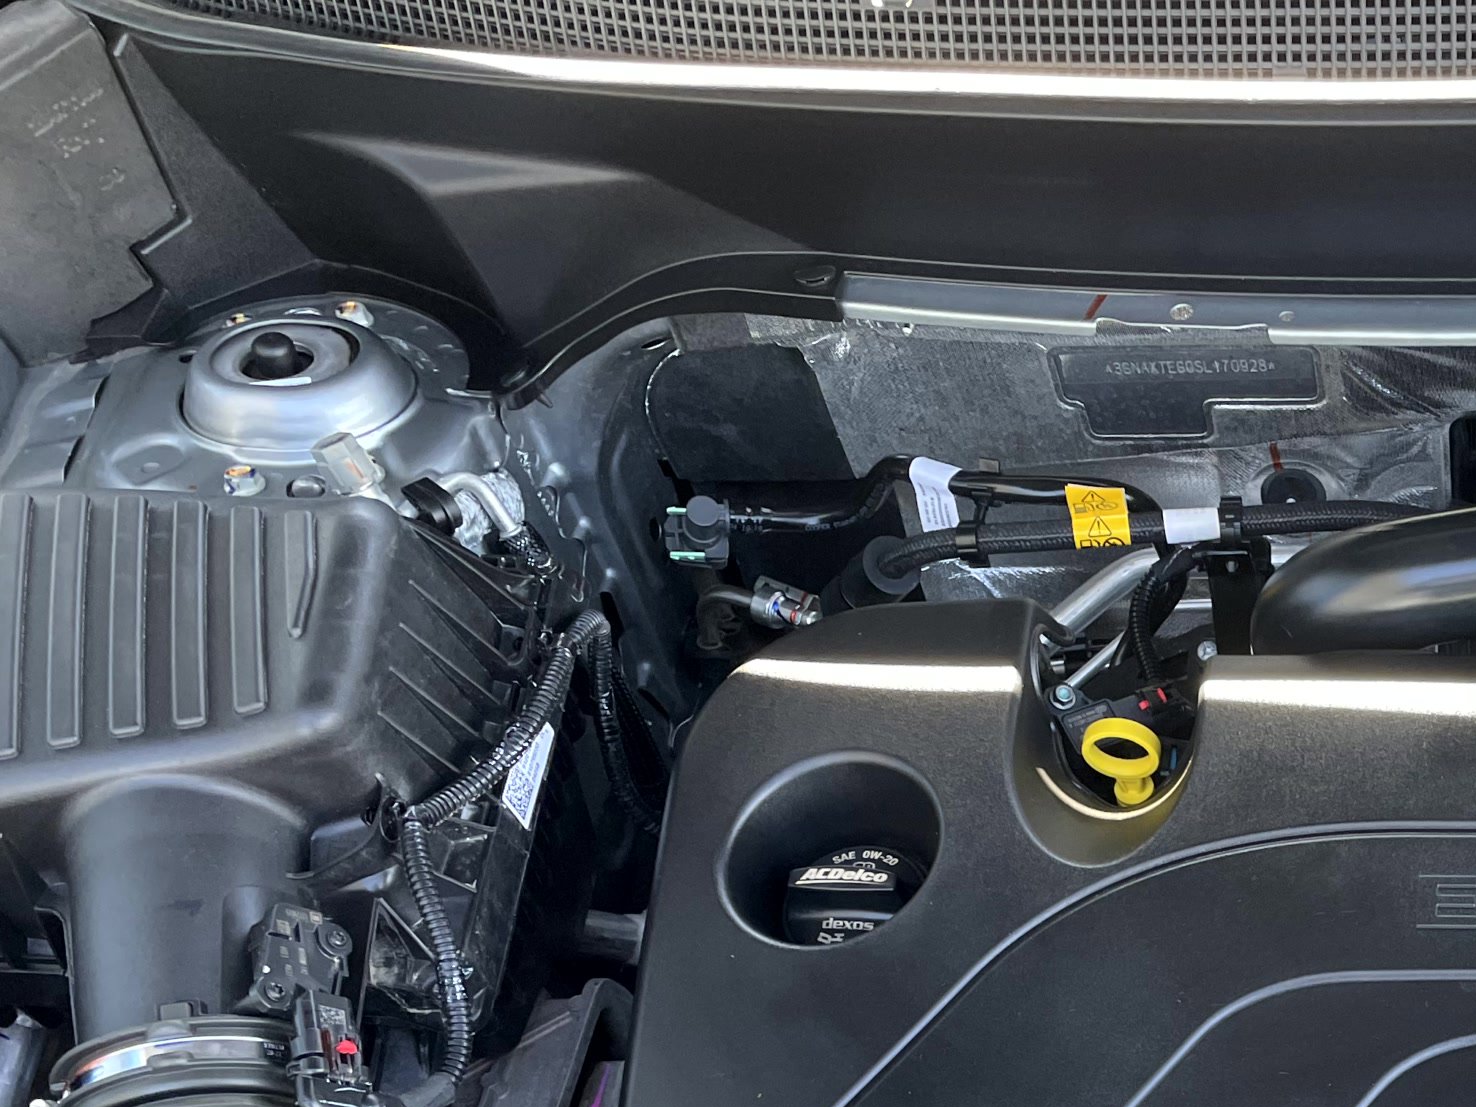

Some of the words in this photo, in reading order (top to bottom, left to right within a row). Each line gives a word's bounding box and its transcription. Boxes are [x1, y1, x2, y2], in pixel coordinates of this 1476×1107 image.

[832, 851, 856, 865] SAE
[862, 850, 899, 867] 0W-20
[800, 868, 888, 883] ACDelco
[822, 917, 875, 931] dexos
